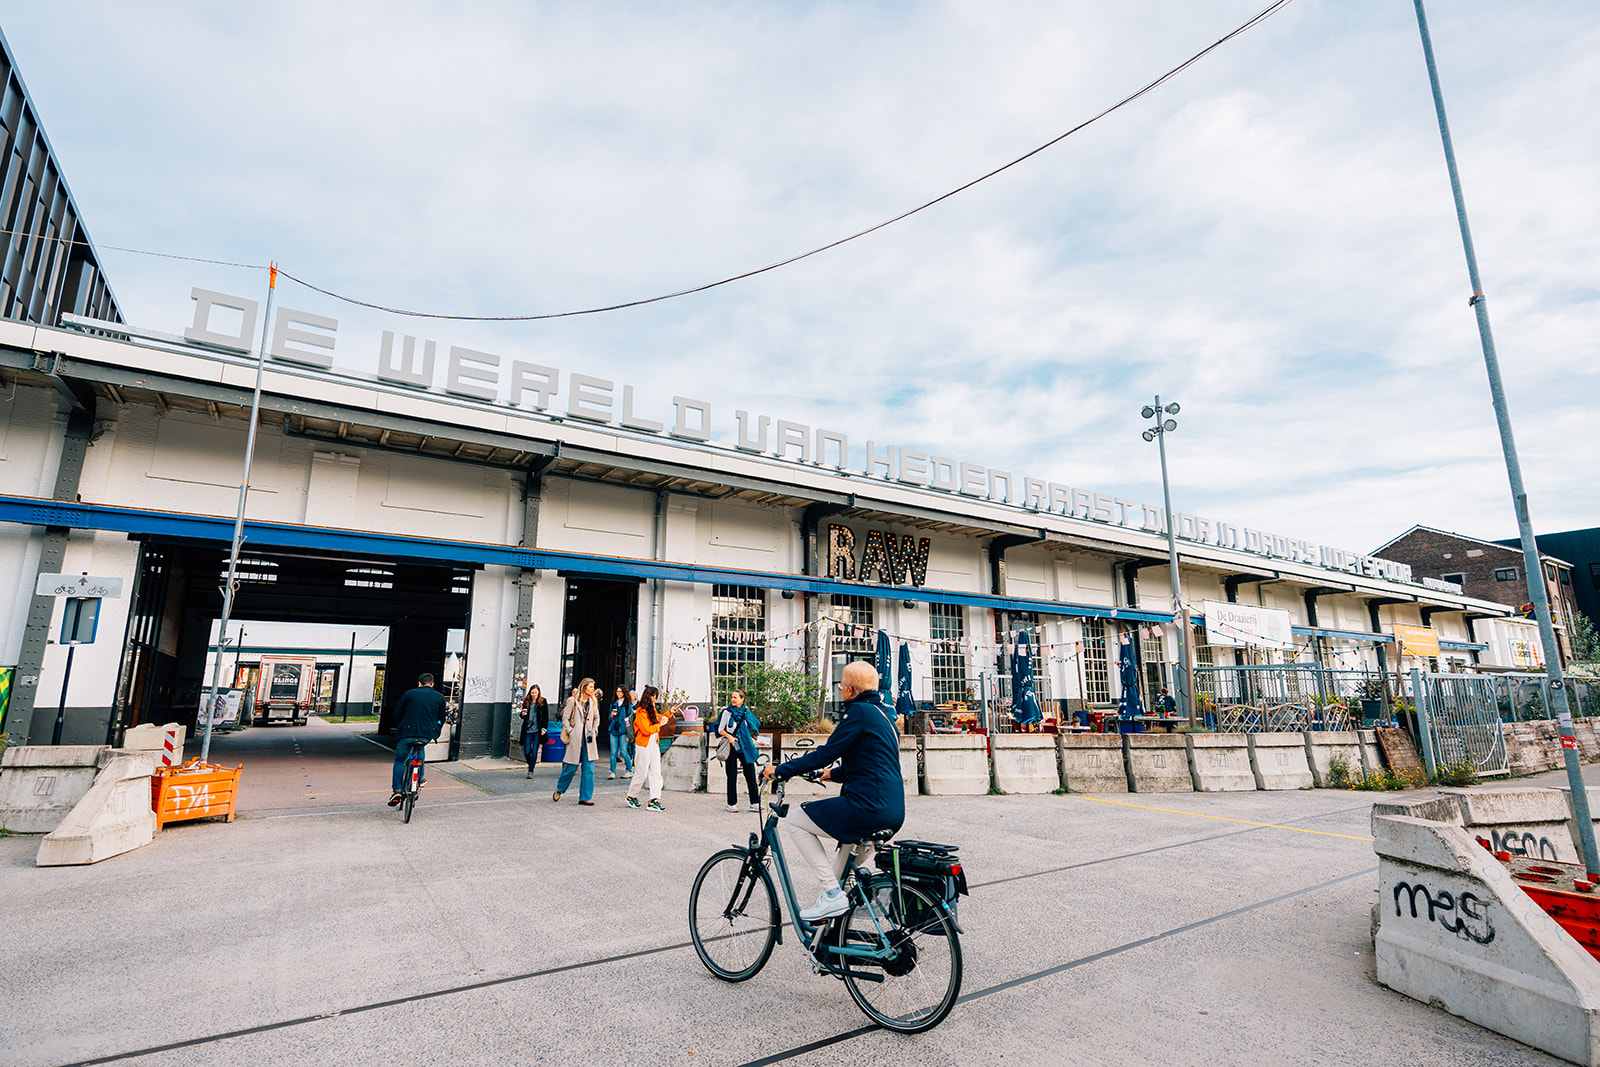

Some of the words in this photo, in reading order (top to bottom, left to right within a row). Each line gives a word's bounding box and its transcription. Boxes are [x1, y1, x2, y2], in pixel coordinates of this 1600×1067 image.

[184, 286, 338, 370] DE
[377, 330, 712, 442] WERELD
[736, 410, 849, 469] VAN
[864, 440, 1013, 503] HEDEN
[1023, 477, 1132, 526] RAAST
[1215, 521, 1239, 549] IN
[828, 523, 931, 587] RAW
